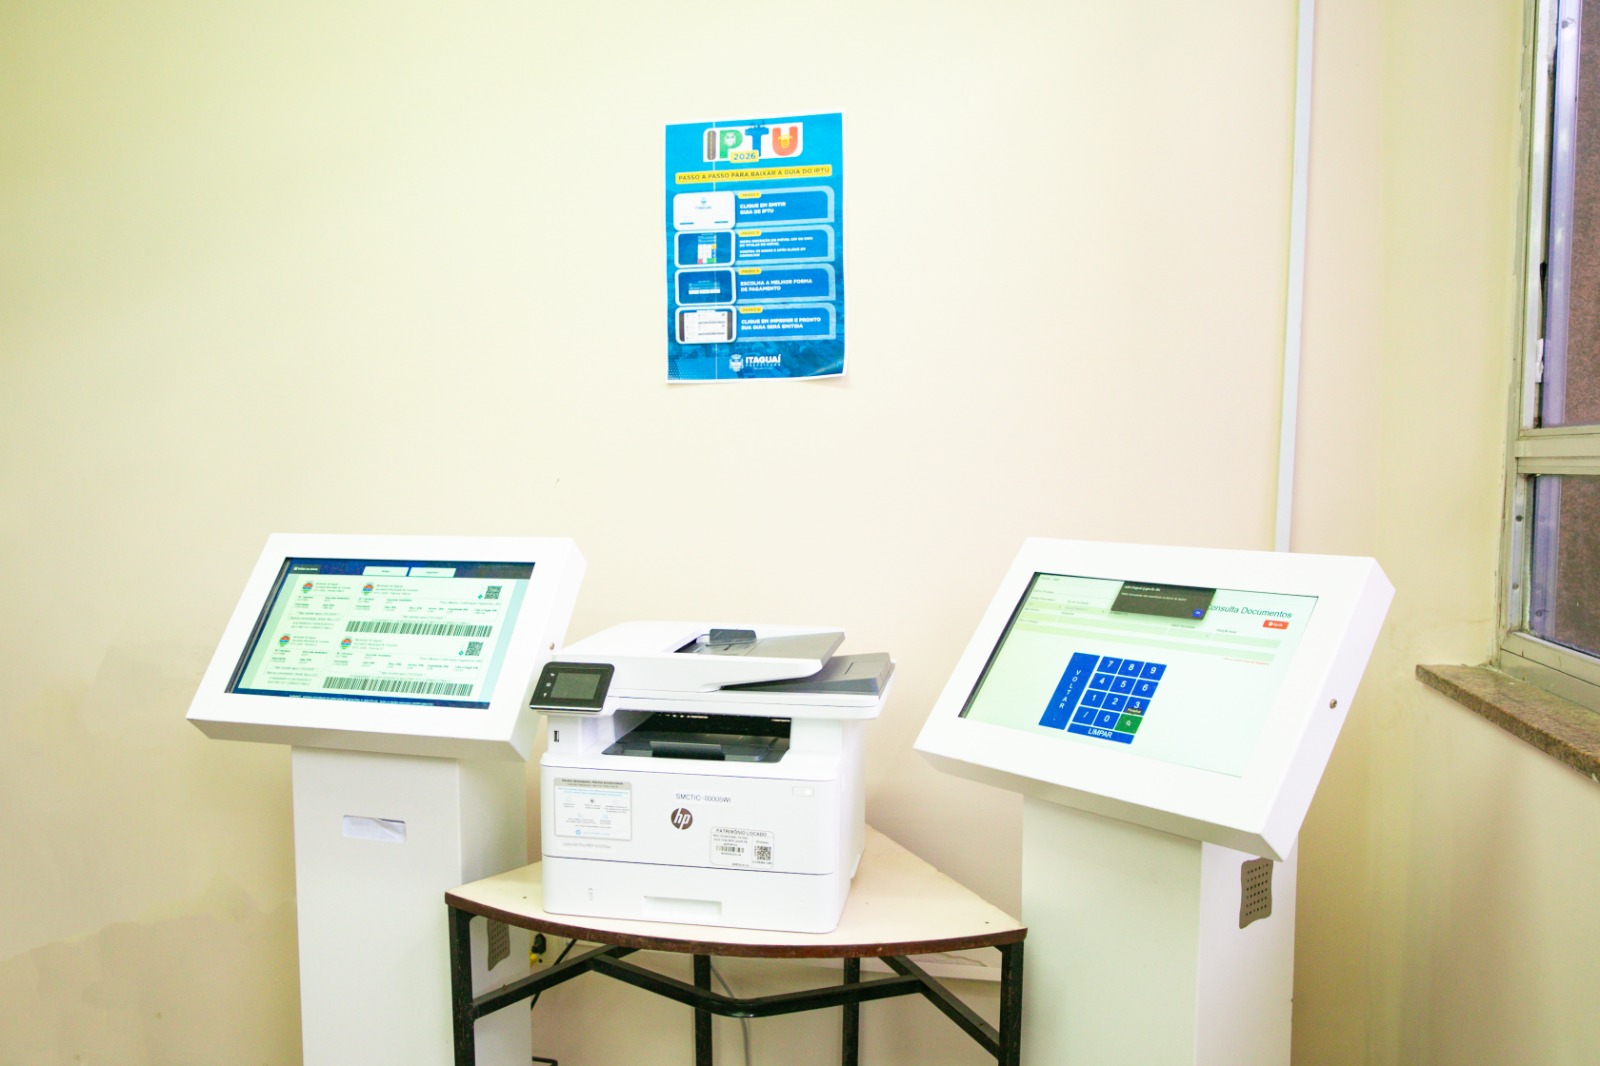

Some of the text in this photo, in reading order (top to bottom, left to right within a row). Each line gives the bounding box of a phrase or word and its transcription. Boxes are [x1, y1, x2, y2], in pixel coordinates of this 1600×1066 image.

[707, 125, 798, 160] IPTU
[746, 354, 781, 364] ITAGUAÍ
[1241, 607, 1292, 618] Documentos
[1059, 670, 1082, 709] VOLTAR
[1088, 728, 1113, 738] LIMPAR
[672, 807, 692, 830] hp
